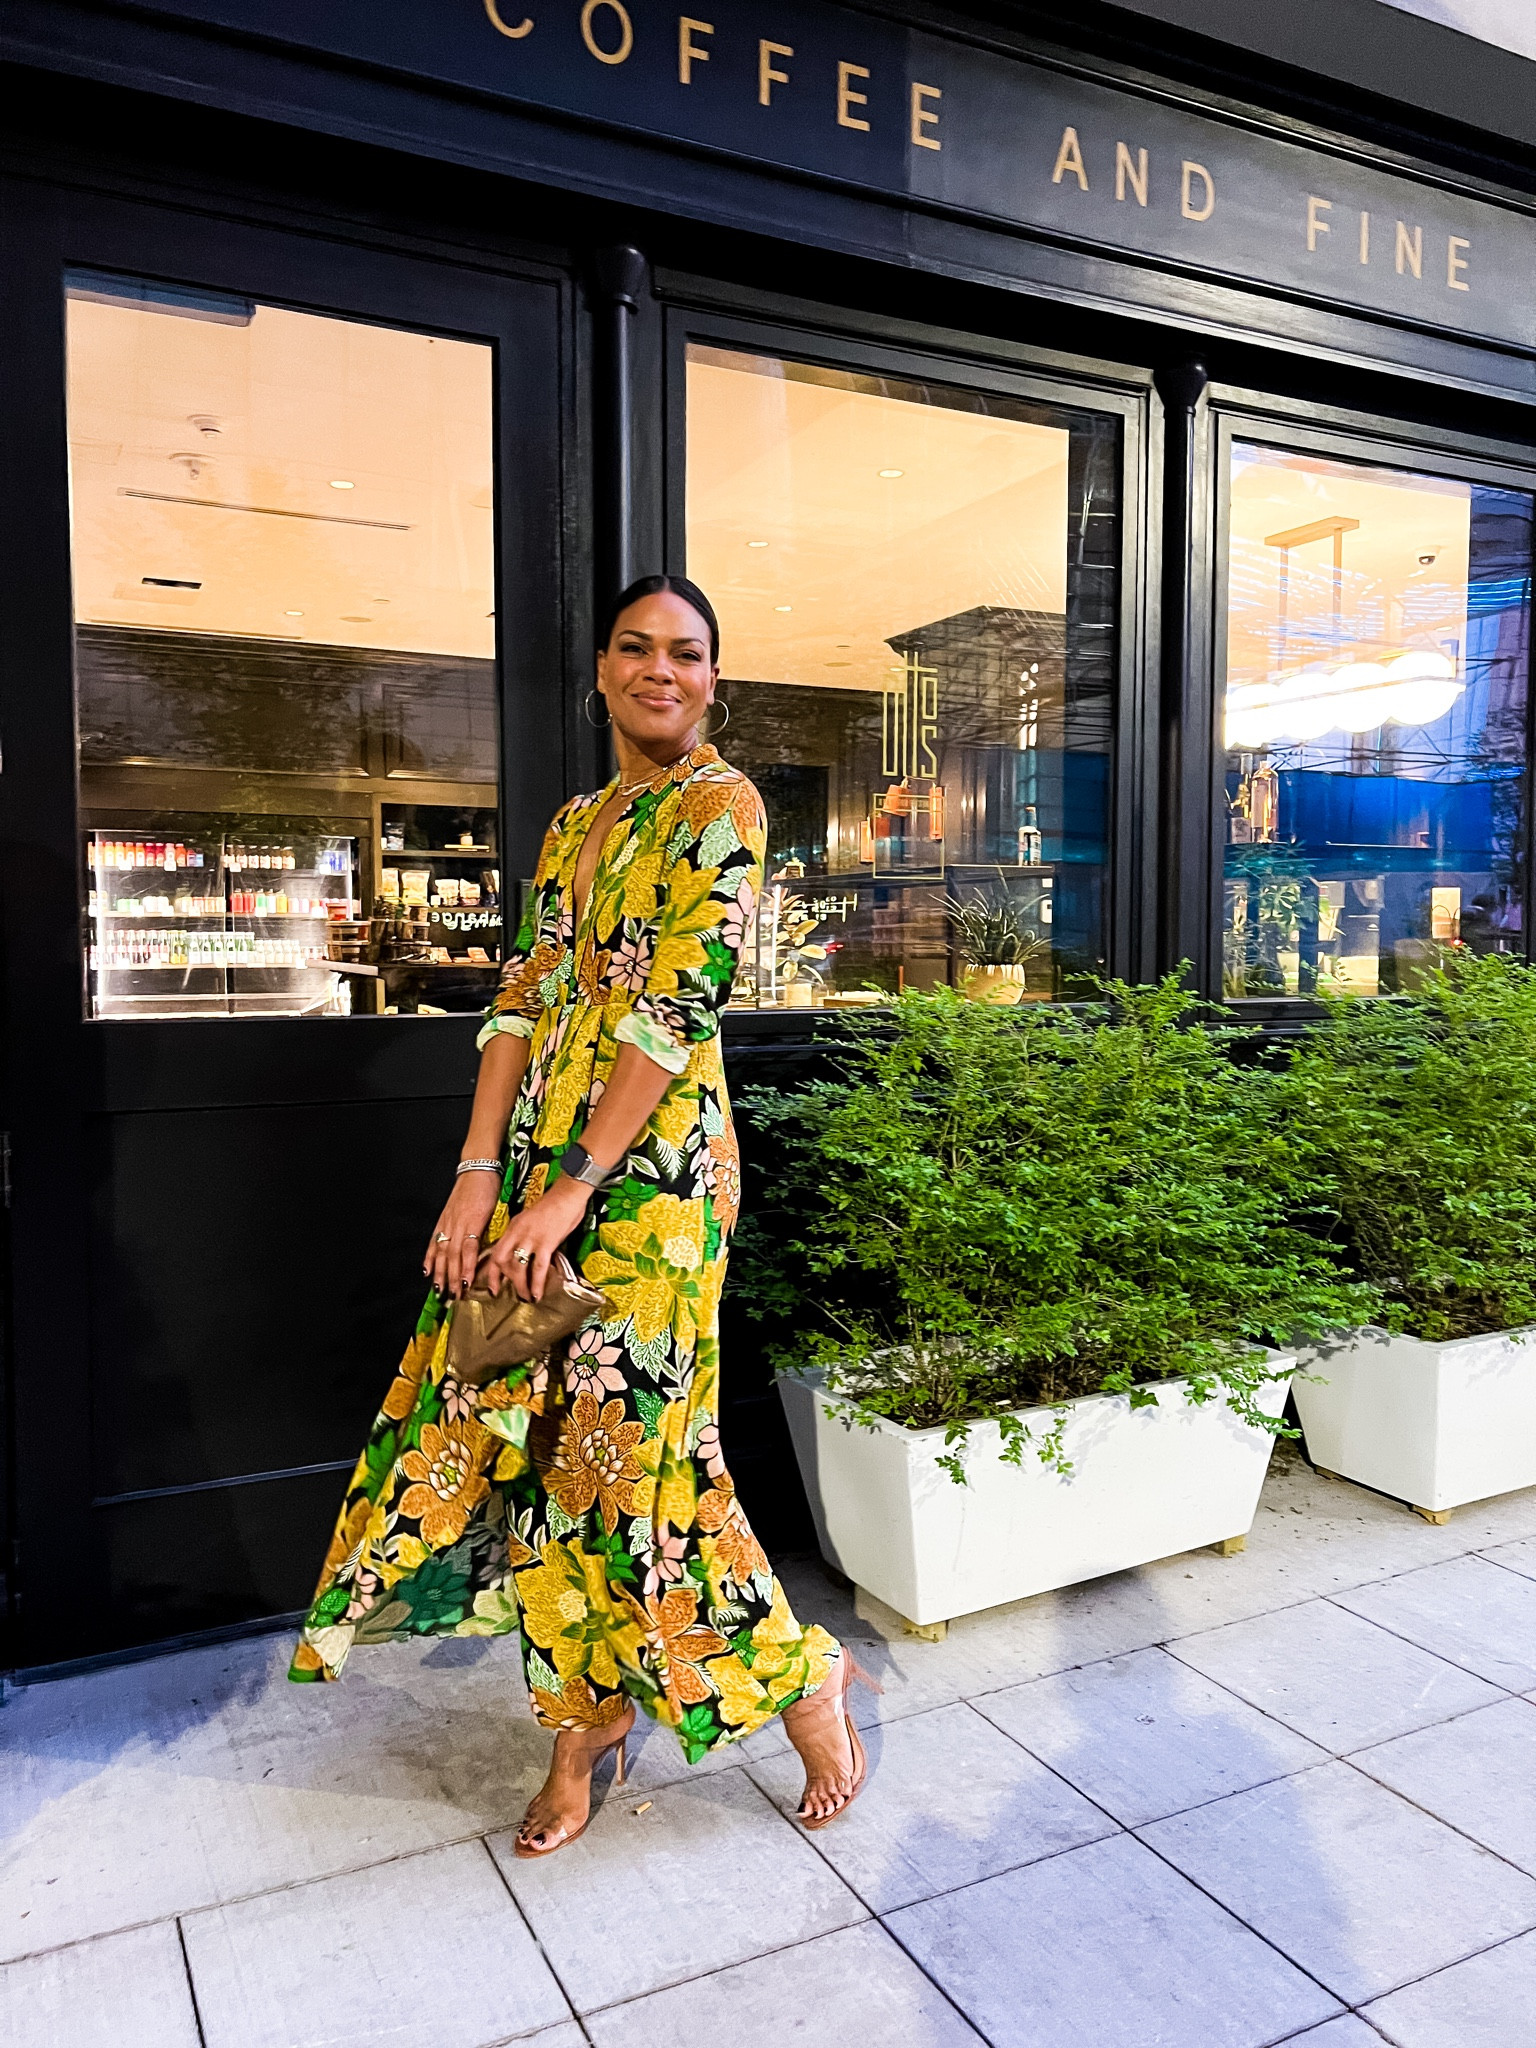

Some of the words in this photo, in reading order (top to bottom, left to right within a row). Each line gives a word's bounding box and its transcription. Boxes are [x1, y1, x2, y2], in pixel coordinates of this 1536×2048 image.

[484, 0, 942, 151] COFFEE
[1052, 126, 1216, 222] AND
[1307, 196, 1471, 291] FINE
